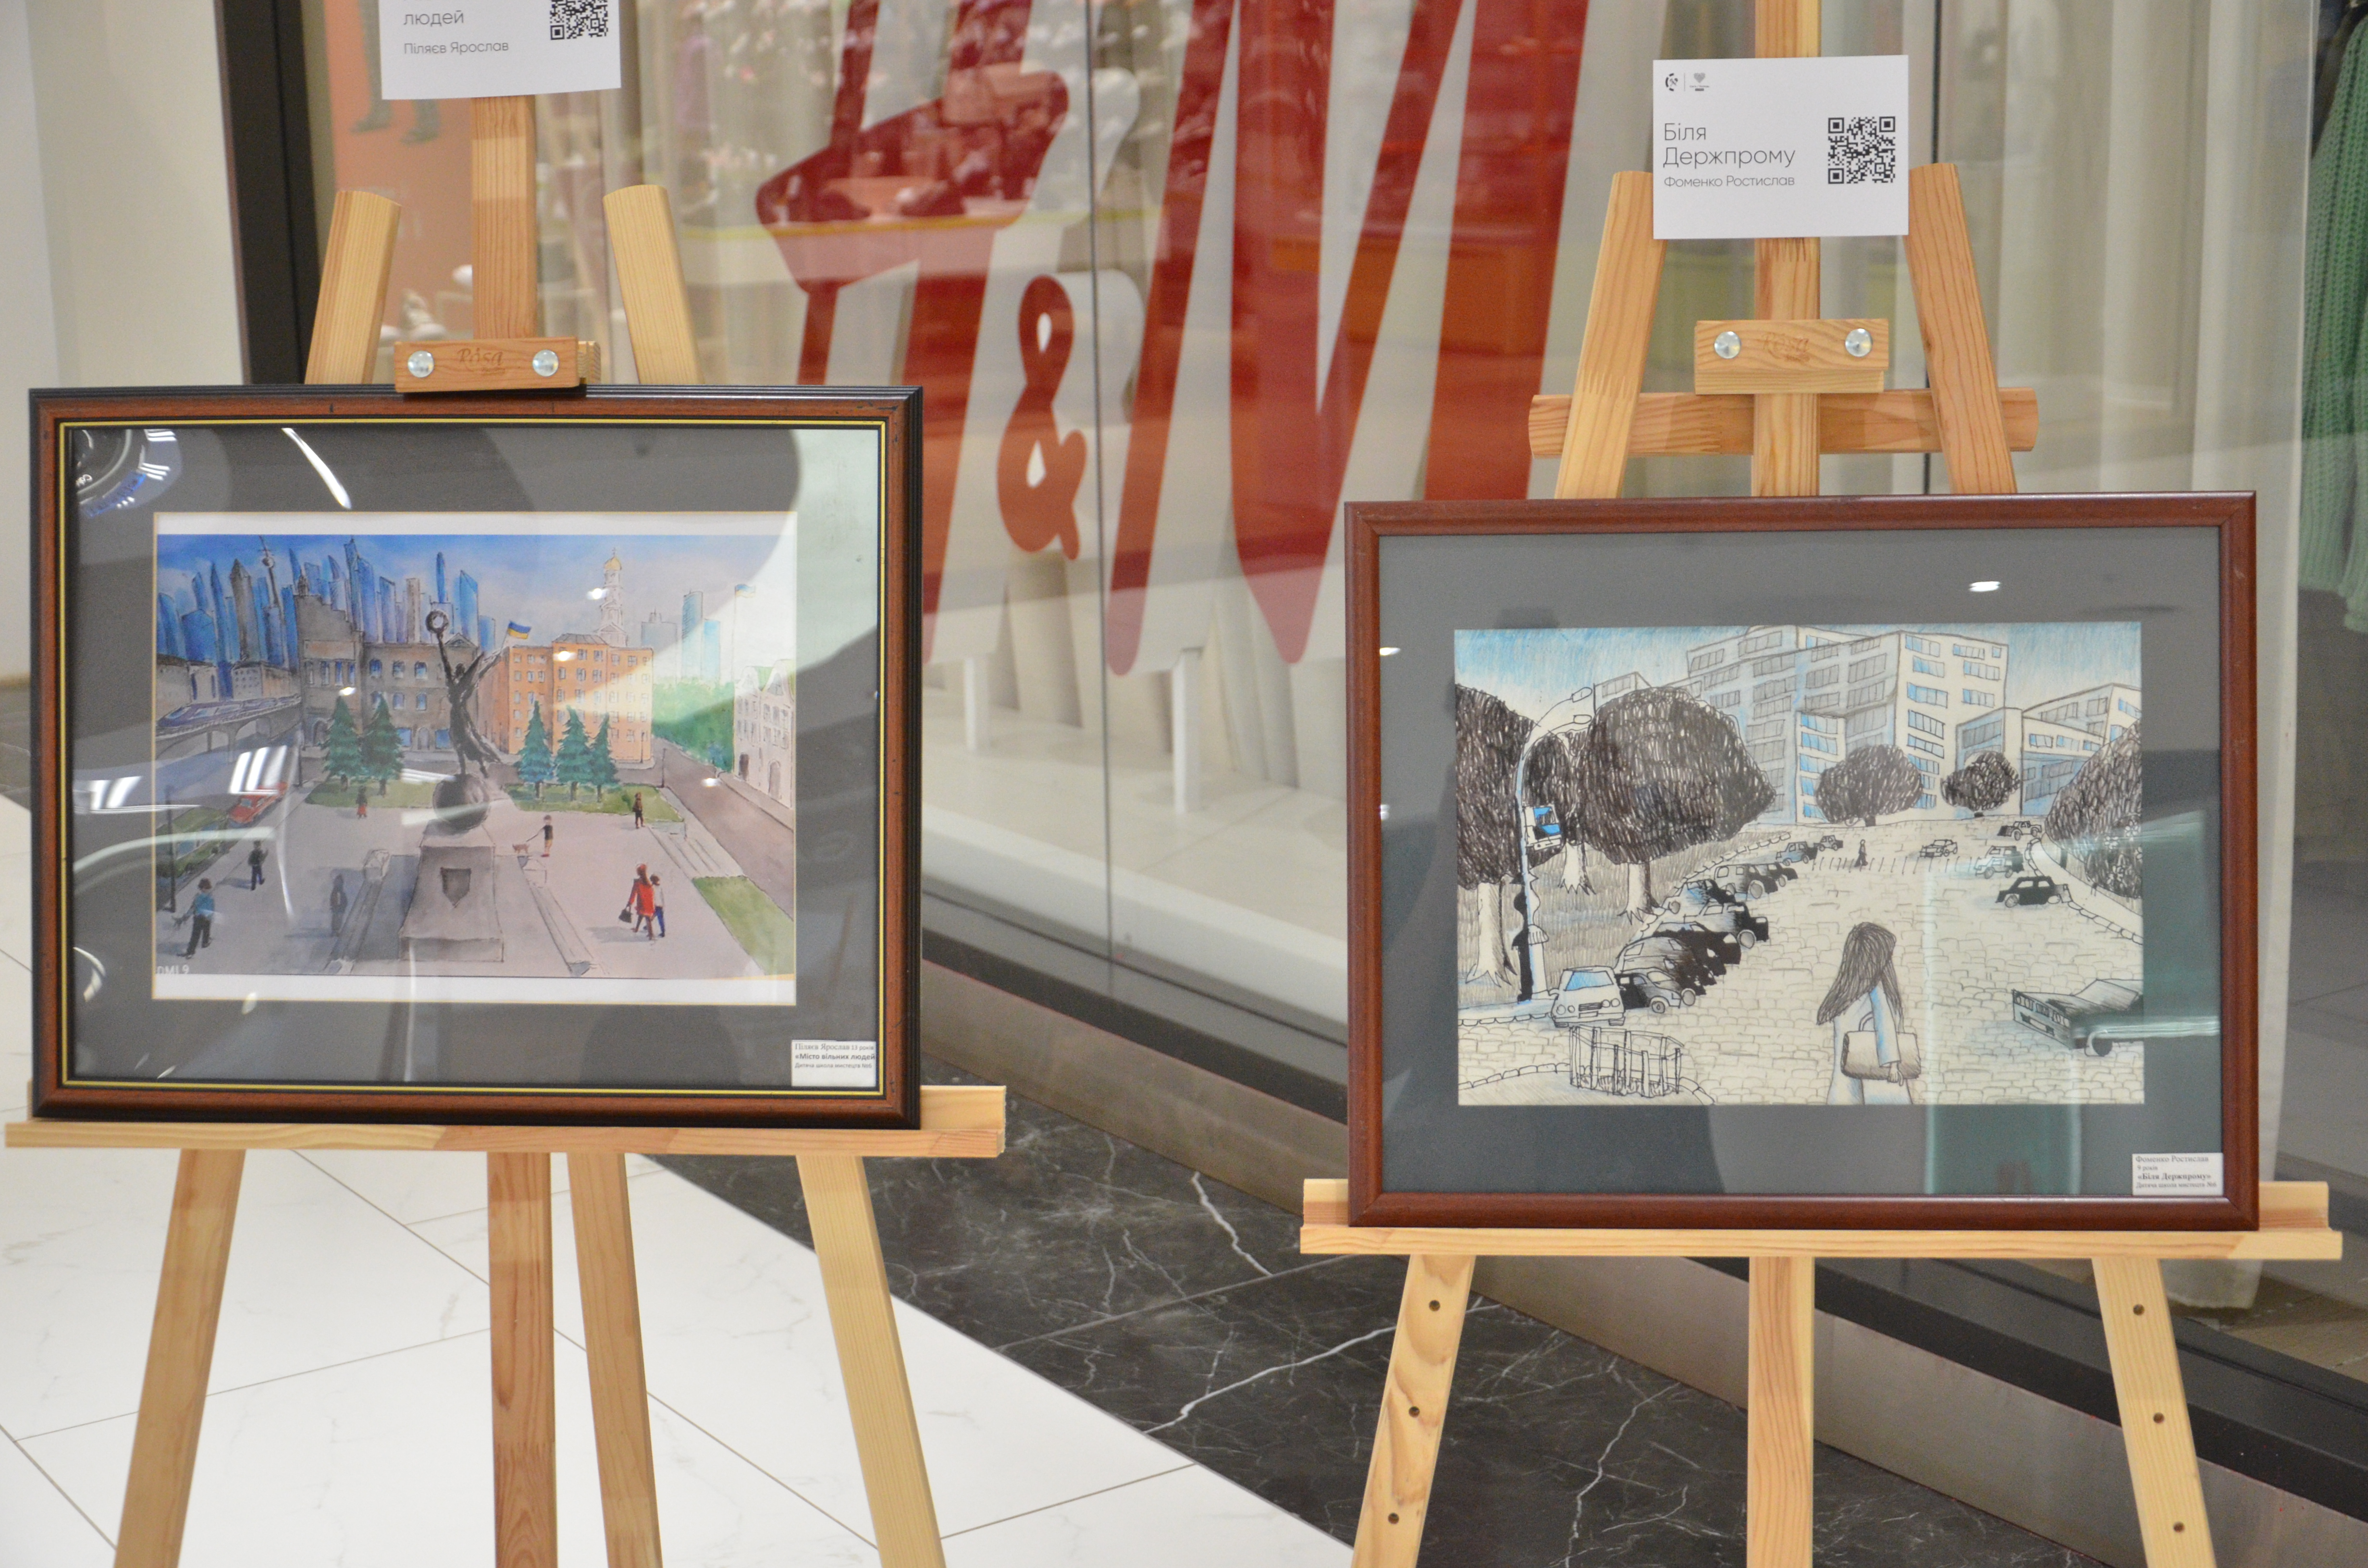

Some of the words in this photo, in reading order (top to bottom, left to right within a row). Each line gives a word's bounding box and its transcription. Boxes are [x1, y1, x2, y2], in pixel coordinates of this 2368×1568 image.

[404, 10, 464, 27] людей
[404, 43, 446, 55] Піляєв
[450, 41, 509, 55] Ярослав
[1664, 123, 1706, 140] Біля
[1663, 147, 1796, 169] Держпрому
[1664, 176, 1723, 187] Фоменко
[1727, 175, 1795, 186] Ростислав
[821, 1043, 850, 1051] Ярослав
